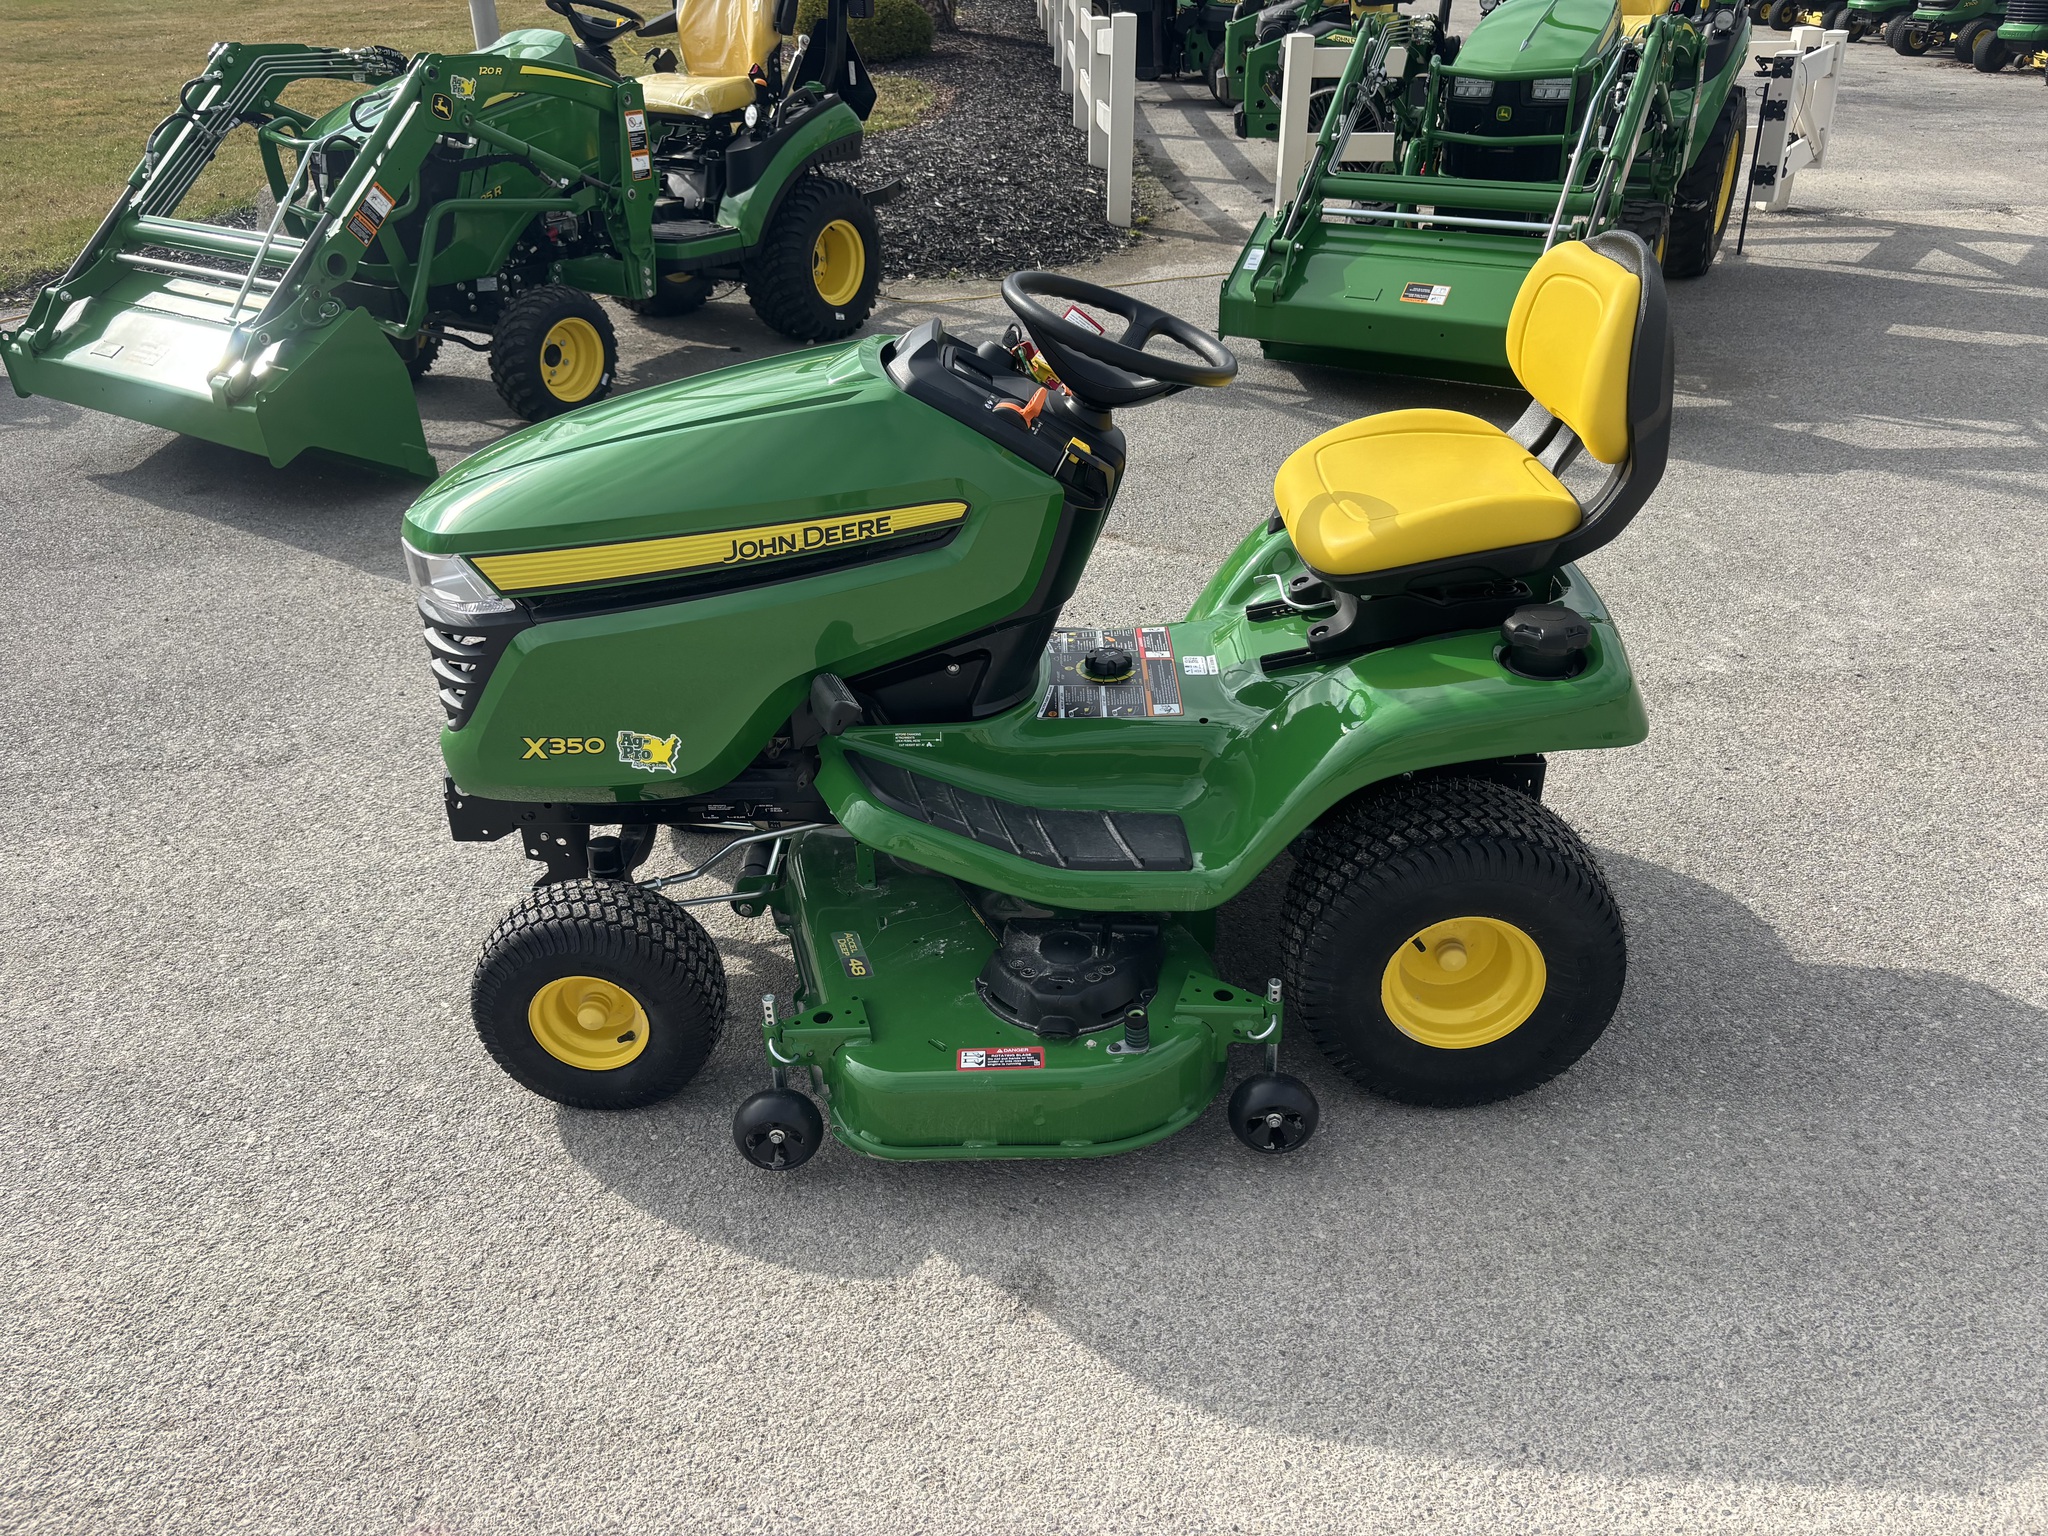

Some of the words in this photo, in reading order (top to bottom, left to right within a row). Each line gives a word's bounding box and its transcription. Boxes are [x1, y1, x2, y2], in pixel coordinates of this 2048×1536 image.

[723, 533, 799, 563] JOHN
[802, 515, 893, 549] DEERE
[520, 736, 606, 761] X350
[621, 746, 653, 761] Pro
[836, 938, 850, 957] DEEP
[844, 932, 858, 954] ACCEL
[848, 958, 866, 976] 48
